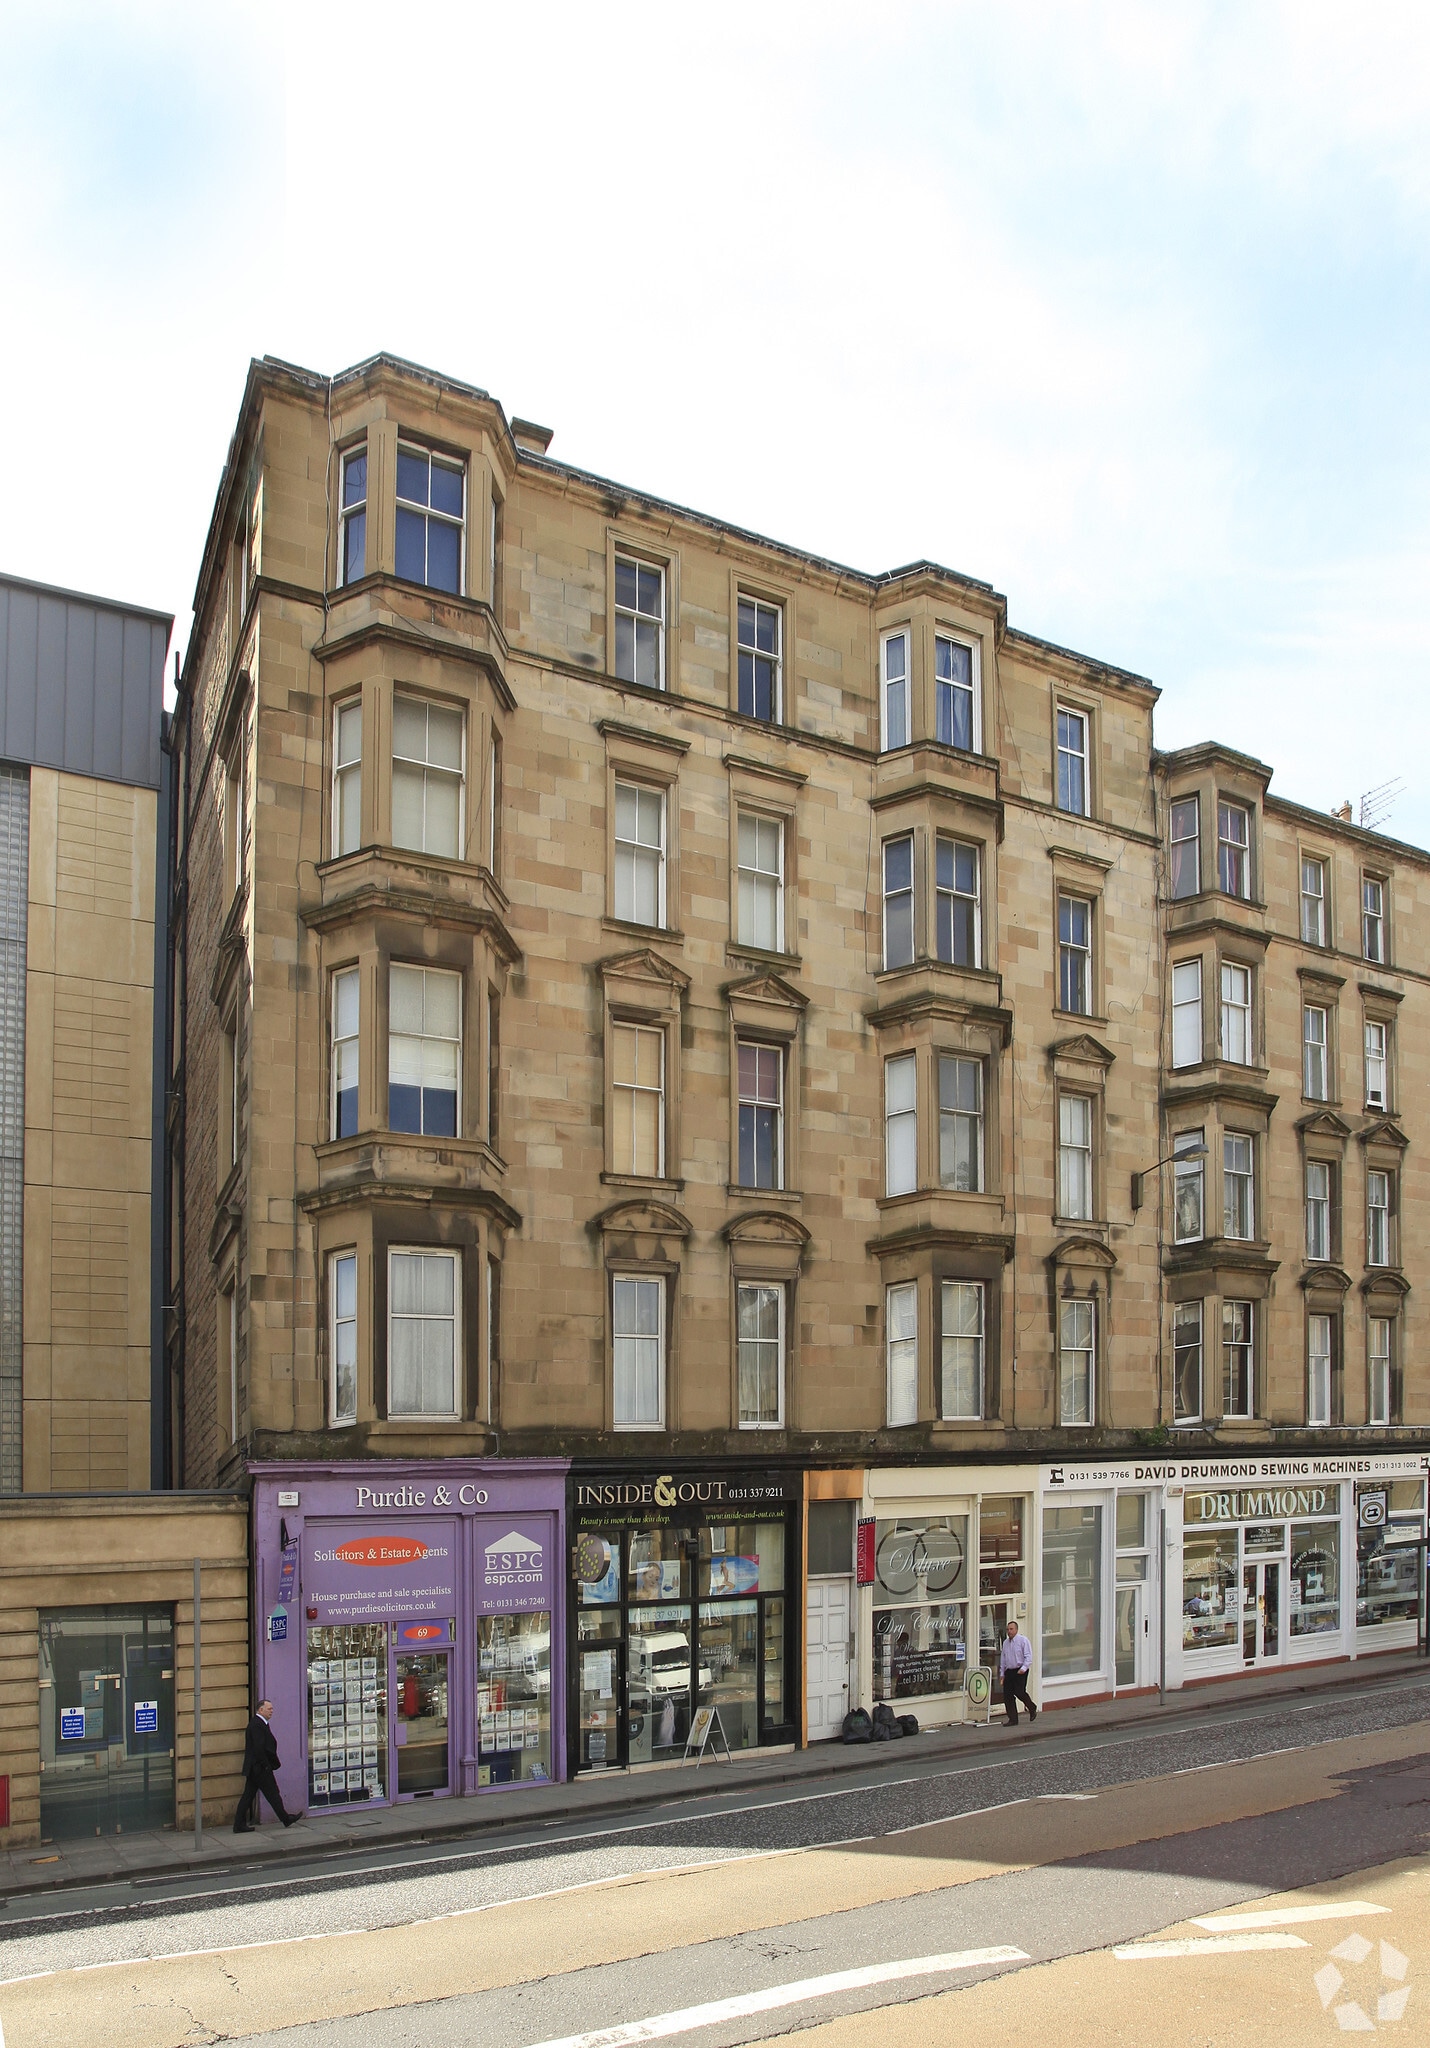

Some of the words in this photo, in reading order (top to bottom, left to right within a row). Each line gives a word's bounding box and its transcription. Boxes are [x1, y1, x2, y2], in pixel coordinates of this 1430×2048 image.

[1069, 1472, 1089, 1480] 0131
[1092, 1472, 1108, 1480] 539
[1110, 1471, 1130, 1479] 7766
[1134, 1466, 1176, 1480] DAVID
[1181, 1464, 1257, 1478] DRUMMOND
[1261, 1462, 1309, 1476] SEWING
[1312, 1461, 1371, 1474] MACHINES
[356, 1486, 426, 1508] Purdie
[432, 1485, 453, 1507] &
[458, 1484, 489, 1505] Co
[577, 1484, 653, 1505] INSIDE
[654, 1475, 677, 1507] &
[678, 1481, 727, 1502] OUT
[728, 1489, 747, 1499] 0131
[749, 1488, 763, 1498] 337
[765, 1487, 784, 1497] 9211
[1200, 1489, 1326, 1519] DRUMMOND
[580, 1516, 602, 1526] Beauty
[603, 1516, 609, 1524] is
[627, 1515, 641, 1523] than
[642, 1515, 655, 1523] skin
[655, 1514, 671, 1525] deep.
[705, 1509, 785, 1520] www.inside-and-out.co.uk
[314, 1549, 364, 1561] Solicitors
[367, 1548, 377, 1560] &
[380, 1547, 411, 1559] Estate
[413, 1546, 449, 1560] Agents
[889, 1546, 952, 1575] Deluxe
[1292, 1551, 1308, 1569] DAVID
[485, 1552, 543, 1571] ESPC
[484, 1573, 543, 1586] espc.com
[311, 1592, 338, 1602] House
[340, 1590, 376, 1602] purchase
[377, 1588, 393, 1598] and
[394, 1587, 410, 1597] sale
[411, 1586, 452, 1599] specialists
[327, 1601, 437, 1616] www.purdiesolicitors.co.uk
[482, 1600, 495, 1608] Tel:
[496, 1599, 513, 1607] 0131
[515, 1598, 528, 1606] 346
[529, 1597, 546, 1605] 7240
[417, 1627, 428, 1637] 69
[877, 1614, 906, 1641] Dry
[910, 1611, 964, 1634] Cleaning
[912, 1674, 924, 1682] 313
[975, 1679, 982, 1697] P
